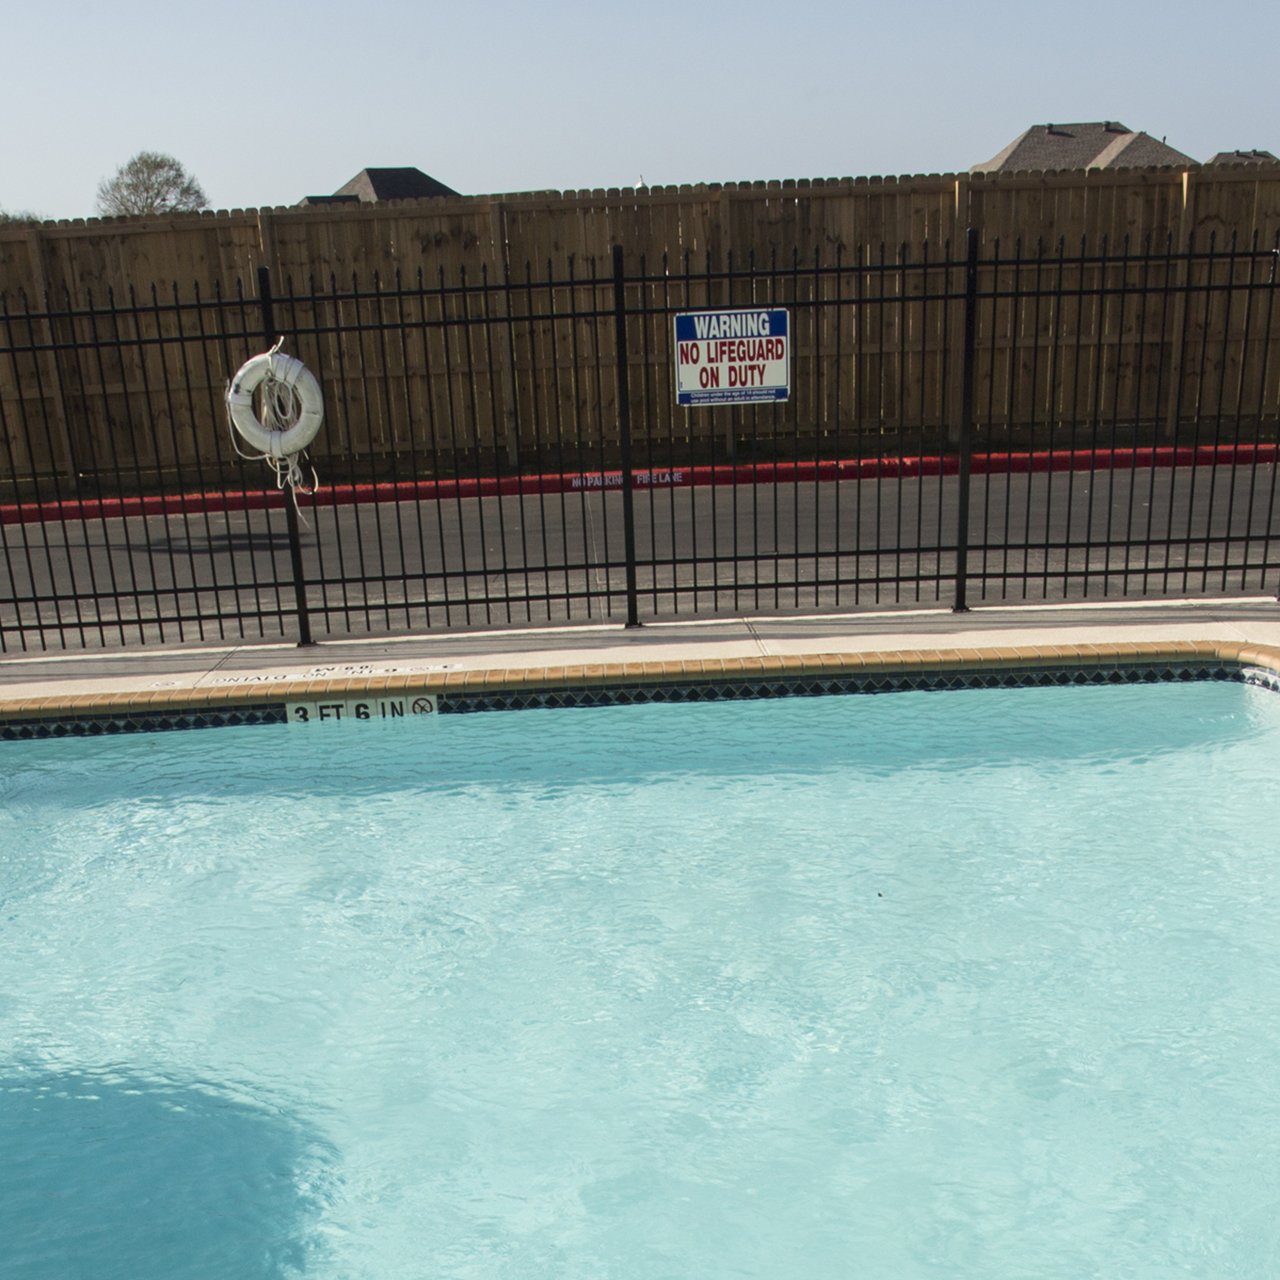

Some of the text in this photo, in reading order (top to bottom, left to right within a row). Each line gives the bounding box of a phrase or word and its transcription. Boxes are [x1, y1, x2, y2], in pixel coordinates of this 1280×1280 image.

[693, 313, 770, 339] WARNING
[680, 338, 785, 365] NO LIFEGUARD
[699, 364, 766, 388] ON DUTY
[294, 700, 404, 722] 3 FT 6 IN
